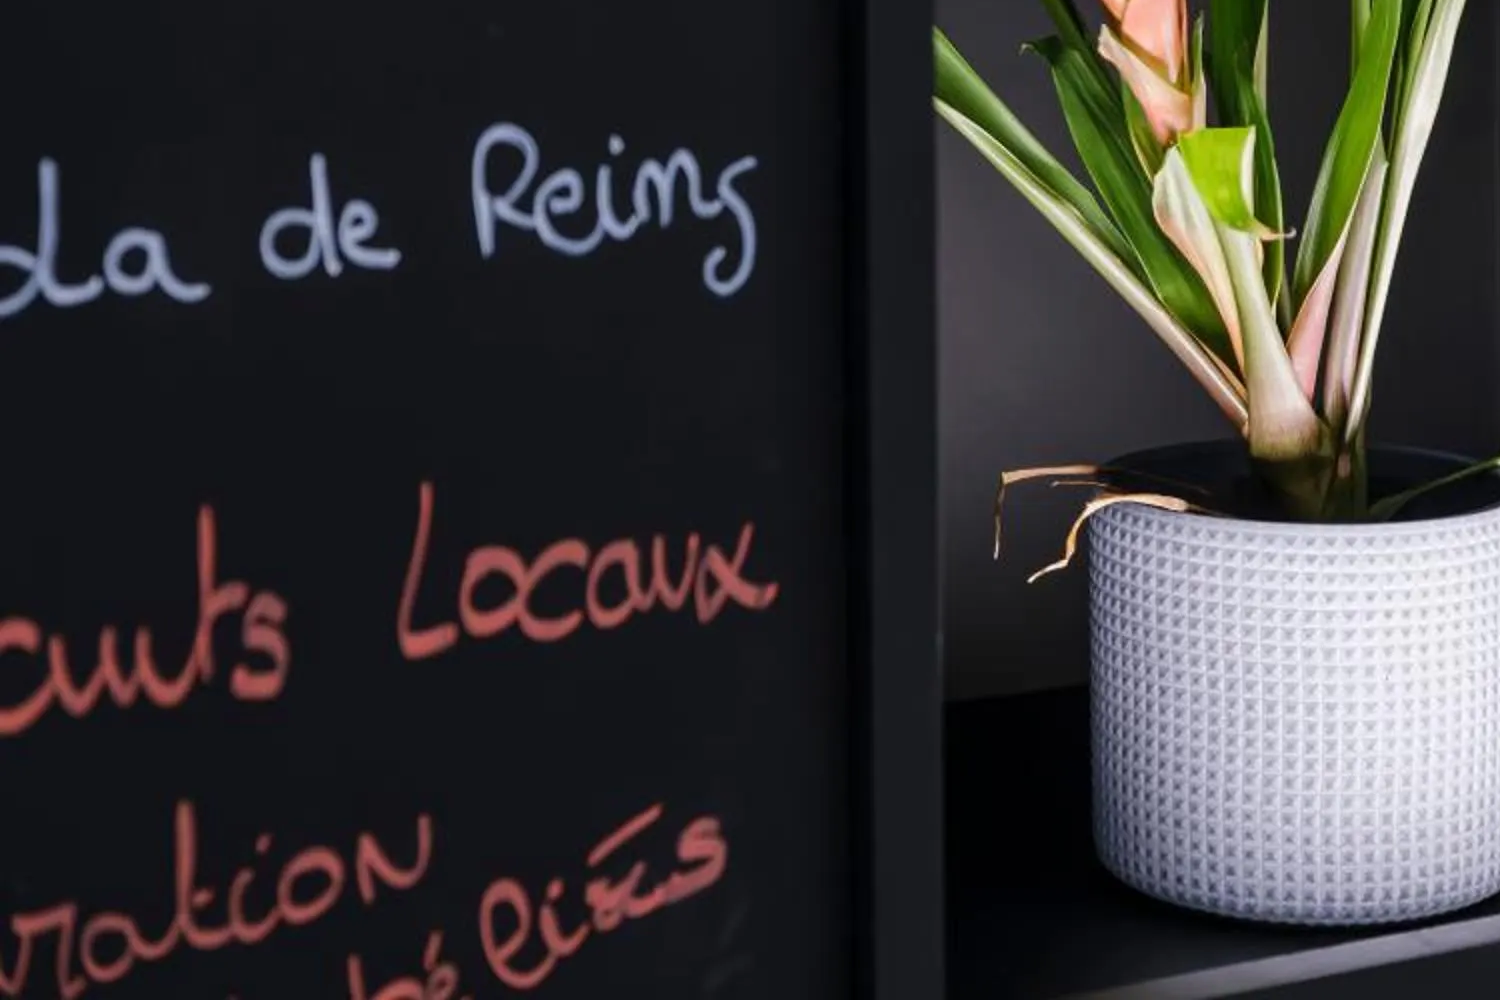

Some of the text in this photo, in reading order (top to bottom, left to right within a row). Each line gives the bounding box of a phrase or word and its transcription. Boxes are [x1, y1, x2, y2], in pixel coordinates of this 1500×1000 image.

[258, 152, 402, 279] de
[470, 121, 758, 297] Reims
[397, 479, 780, 661] Locaux
[0, 797, 434, 1000] ration
